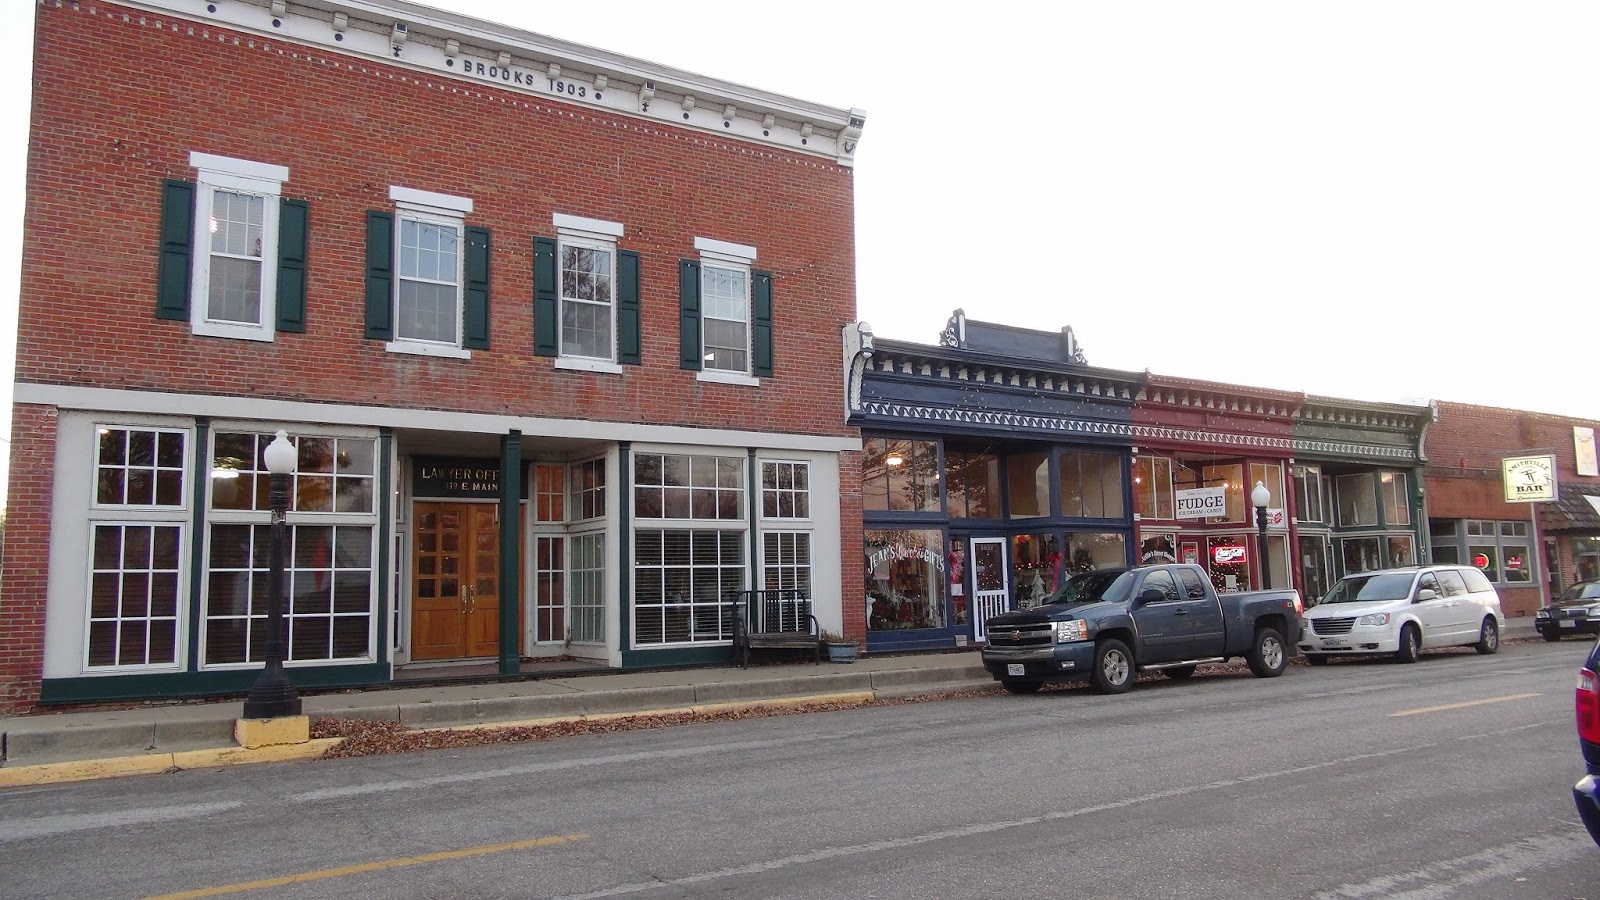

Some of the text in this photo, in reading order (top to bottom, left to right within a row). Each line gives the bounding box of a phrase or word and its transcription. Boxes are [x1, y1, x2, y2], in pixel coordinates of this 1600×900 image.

[464, 60, 586, 97] BROOKS 1903
[1508, 460, 1549, 473] SMITHVILLE
[422, 468, 500, 480] LAWYER OFF
[461, 482, 470, 491] E.
[472, 482, 499, 491] MAIN
[1177, 496, 1223, 510] FUDGE
[924, 549, 944, 572] GIFTS
